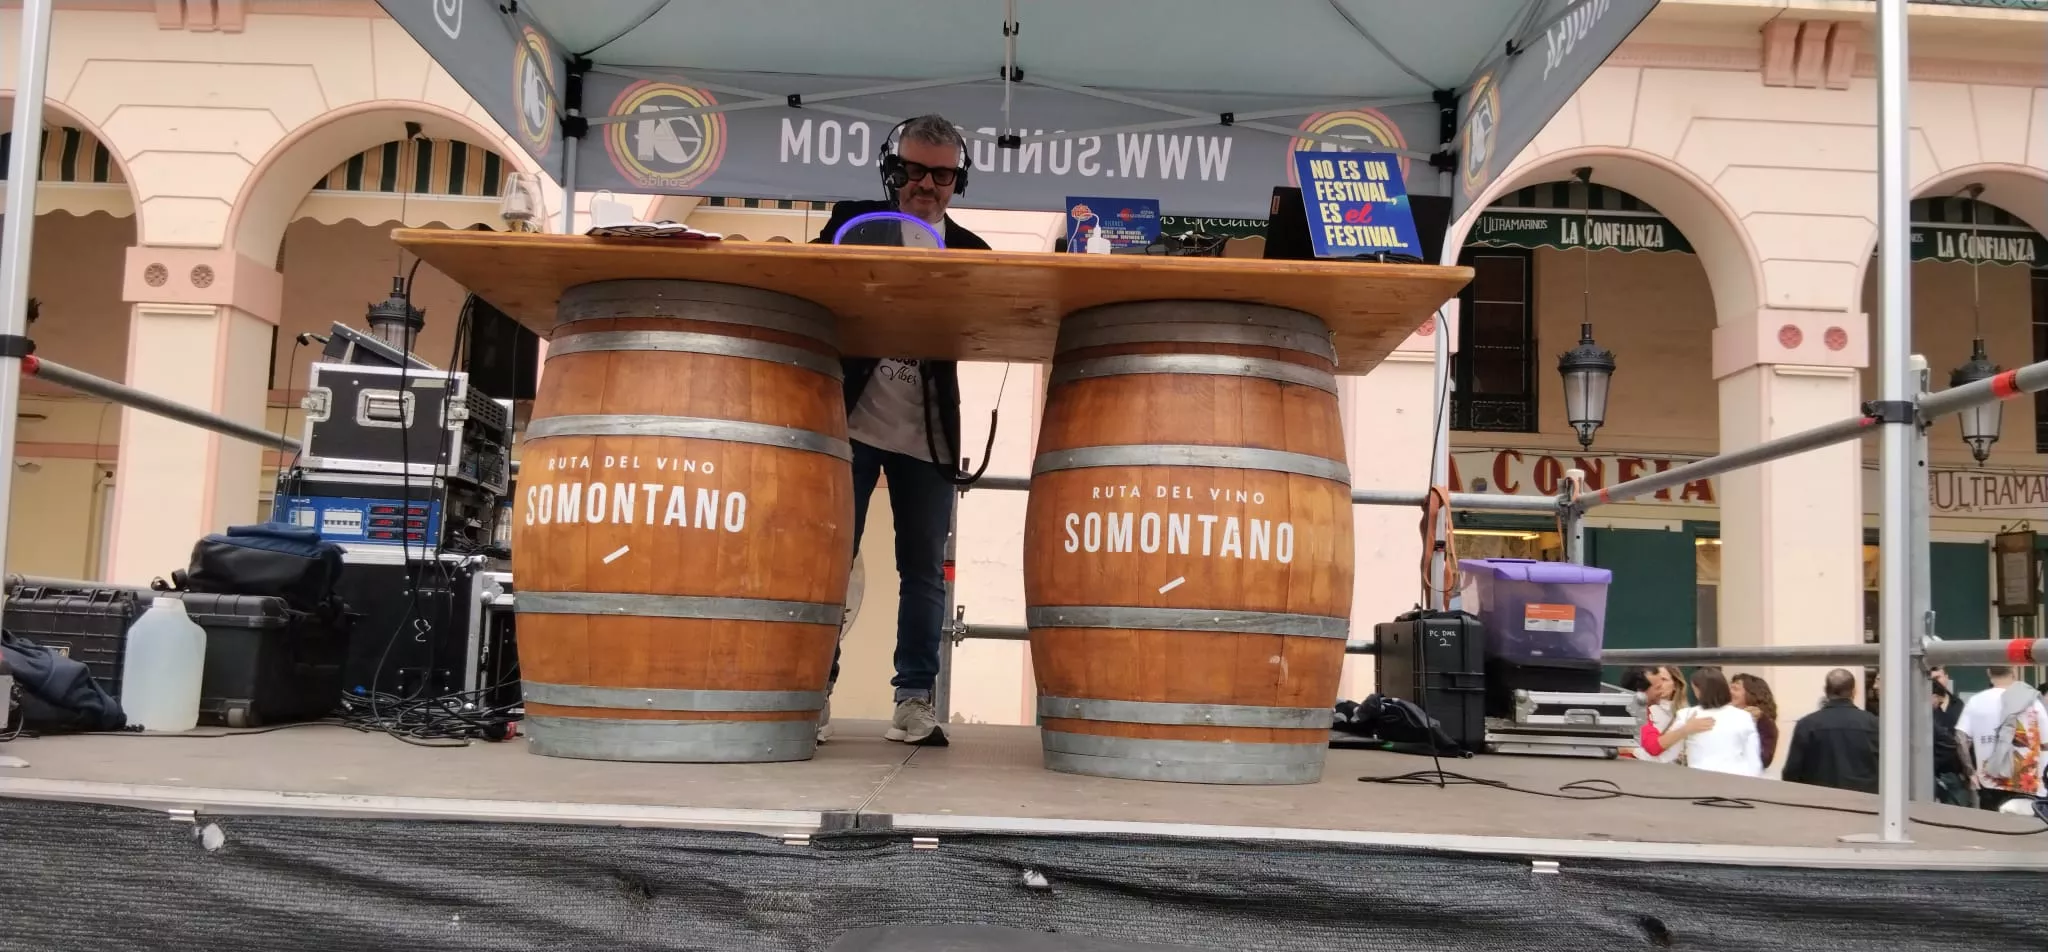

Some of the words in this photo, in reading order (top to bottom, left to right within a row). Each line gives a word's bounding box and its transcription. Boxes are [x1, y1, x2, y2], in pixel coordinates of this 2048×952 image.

[1310, 160, 1335, 179] NO
[1338, 160, 1361, 180] ES
[1364, 161, 1389, 180] UN
[1314, 181, 1398, 206] FESTIVAL,
[1319, 203, 1343, 223] ES
[1345, 202, 1373, 223] el
[1483, 216, 1548, 233] ULTRAMARINOS
[1584, 218, 1664, 247] CONFIANZA
[1324, 225, 1409, 247] FESTIVAL.
[1959, 232, 2036, 261] CONFIANZA
[548, 456, 590, 470] RUTA
[604, 455, 640, 468] DEL
[656, 457, 715, 474] VINO
[1092, 485, 1141, 499] RUTA
[1156, 485, 1194, 499] DEL
[1210, 488, 1265, 504] VINO
[526, 482, 747, 533] SOMONTANO
[1064, 512, 1294, 564] SOMONTANO
